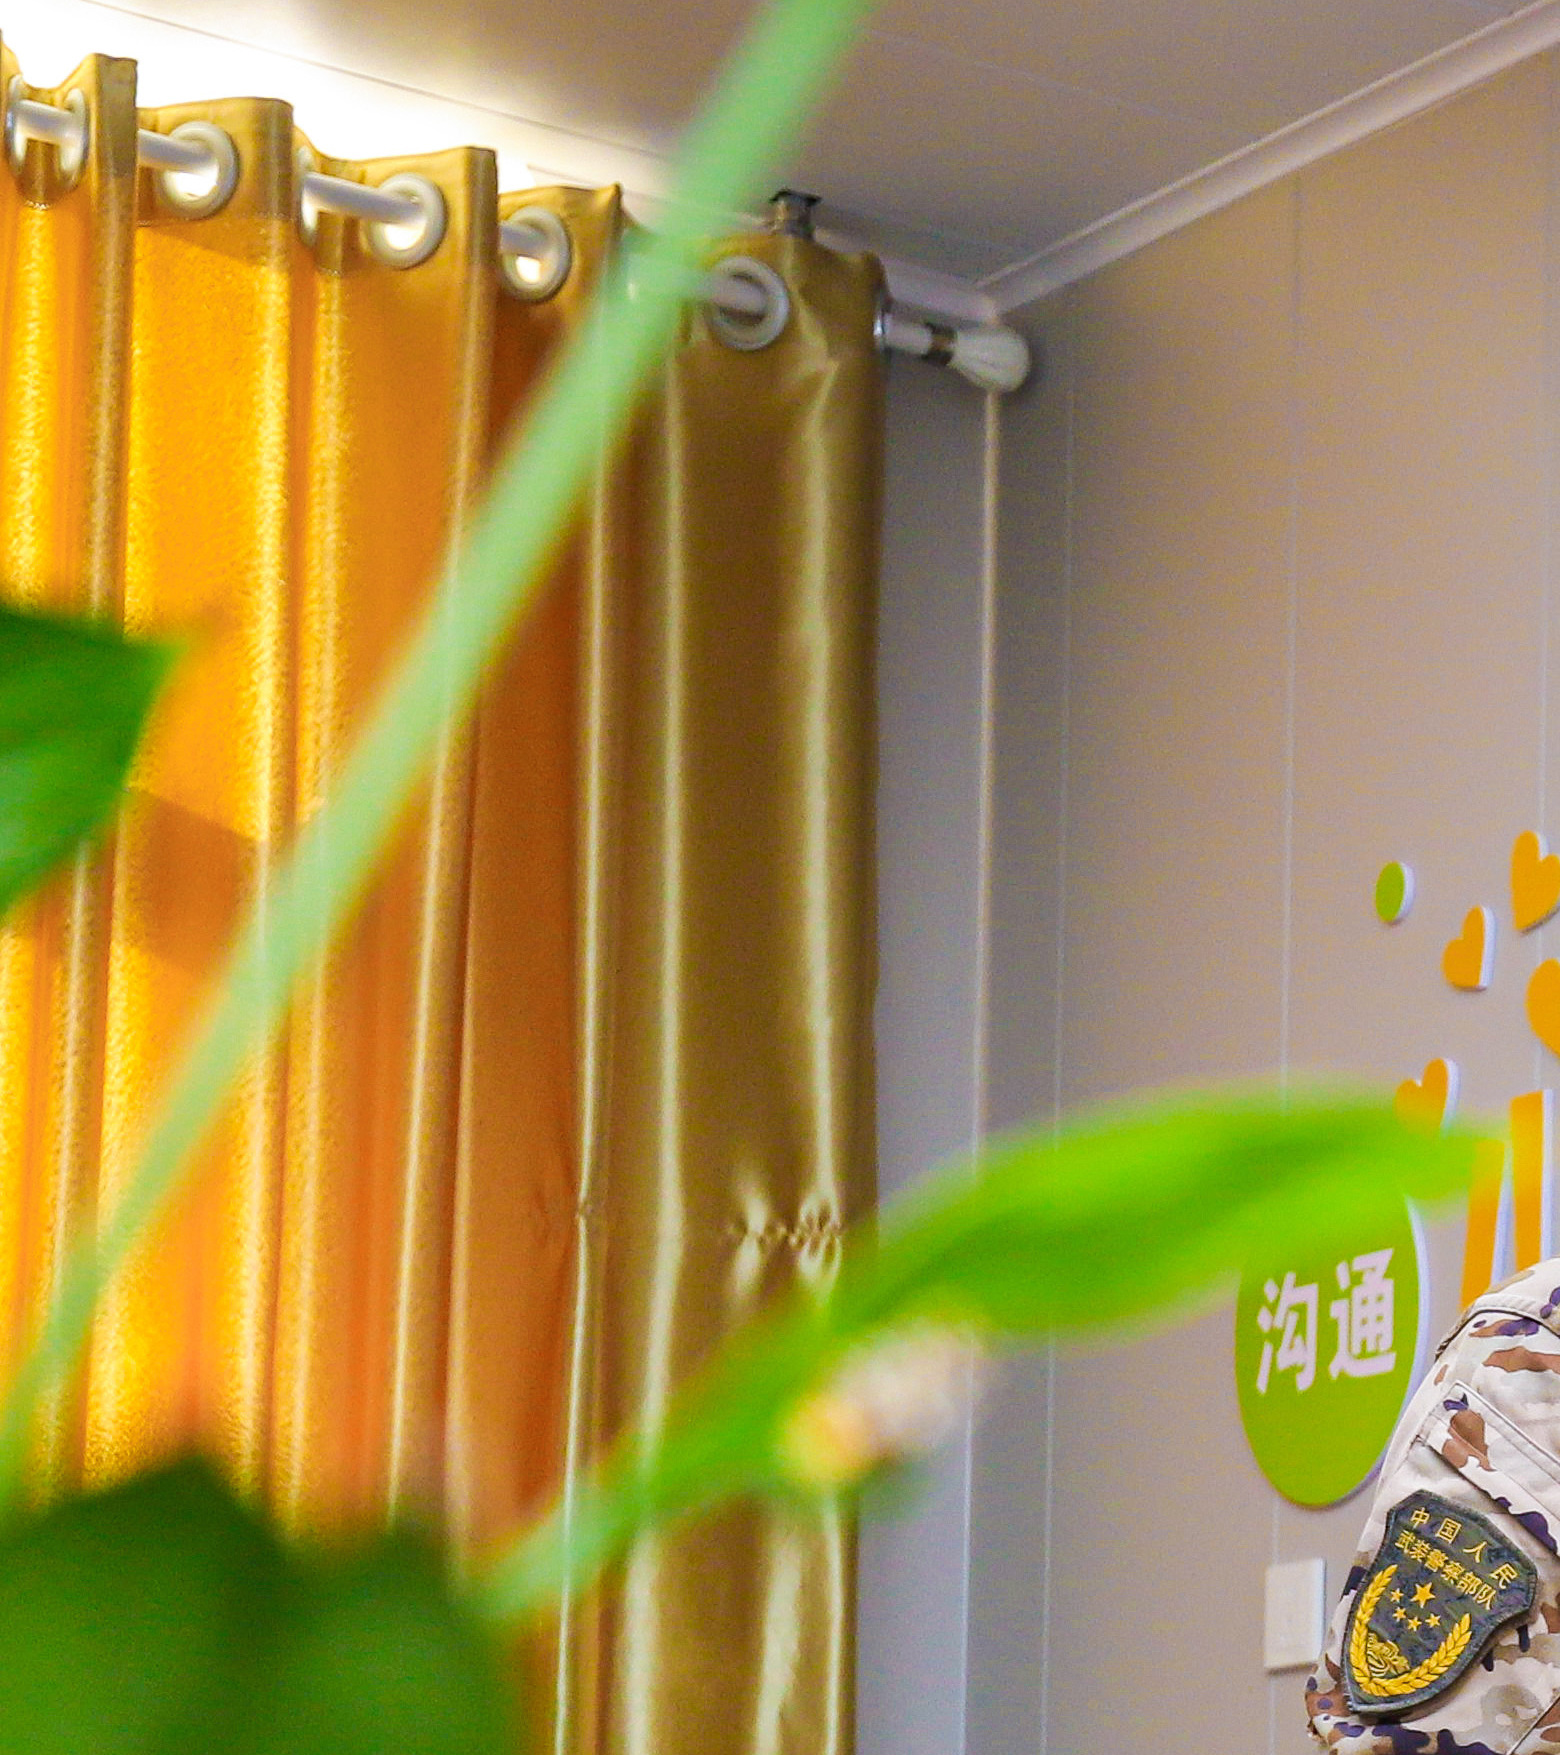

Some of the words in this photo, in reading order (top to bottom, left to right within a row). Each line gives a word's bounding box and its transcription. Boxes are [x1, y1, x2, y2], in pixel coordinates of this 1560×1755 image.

[1256, 1248, 1396, 1395] 沟通
[1395, 1529, 1498, 1611] 武装警察部队
[1410, 1506, 1519, 1590] 中国人民
